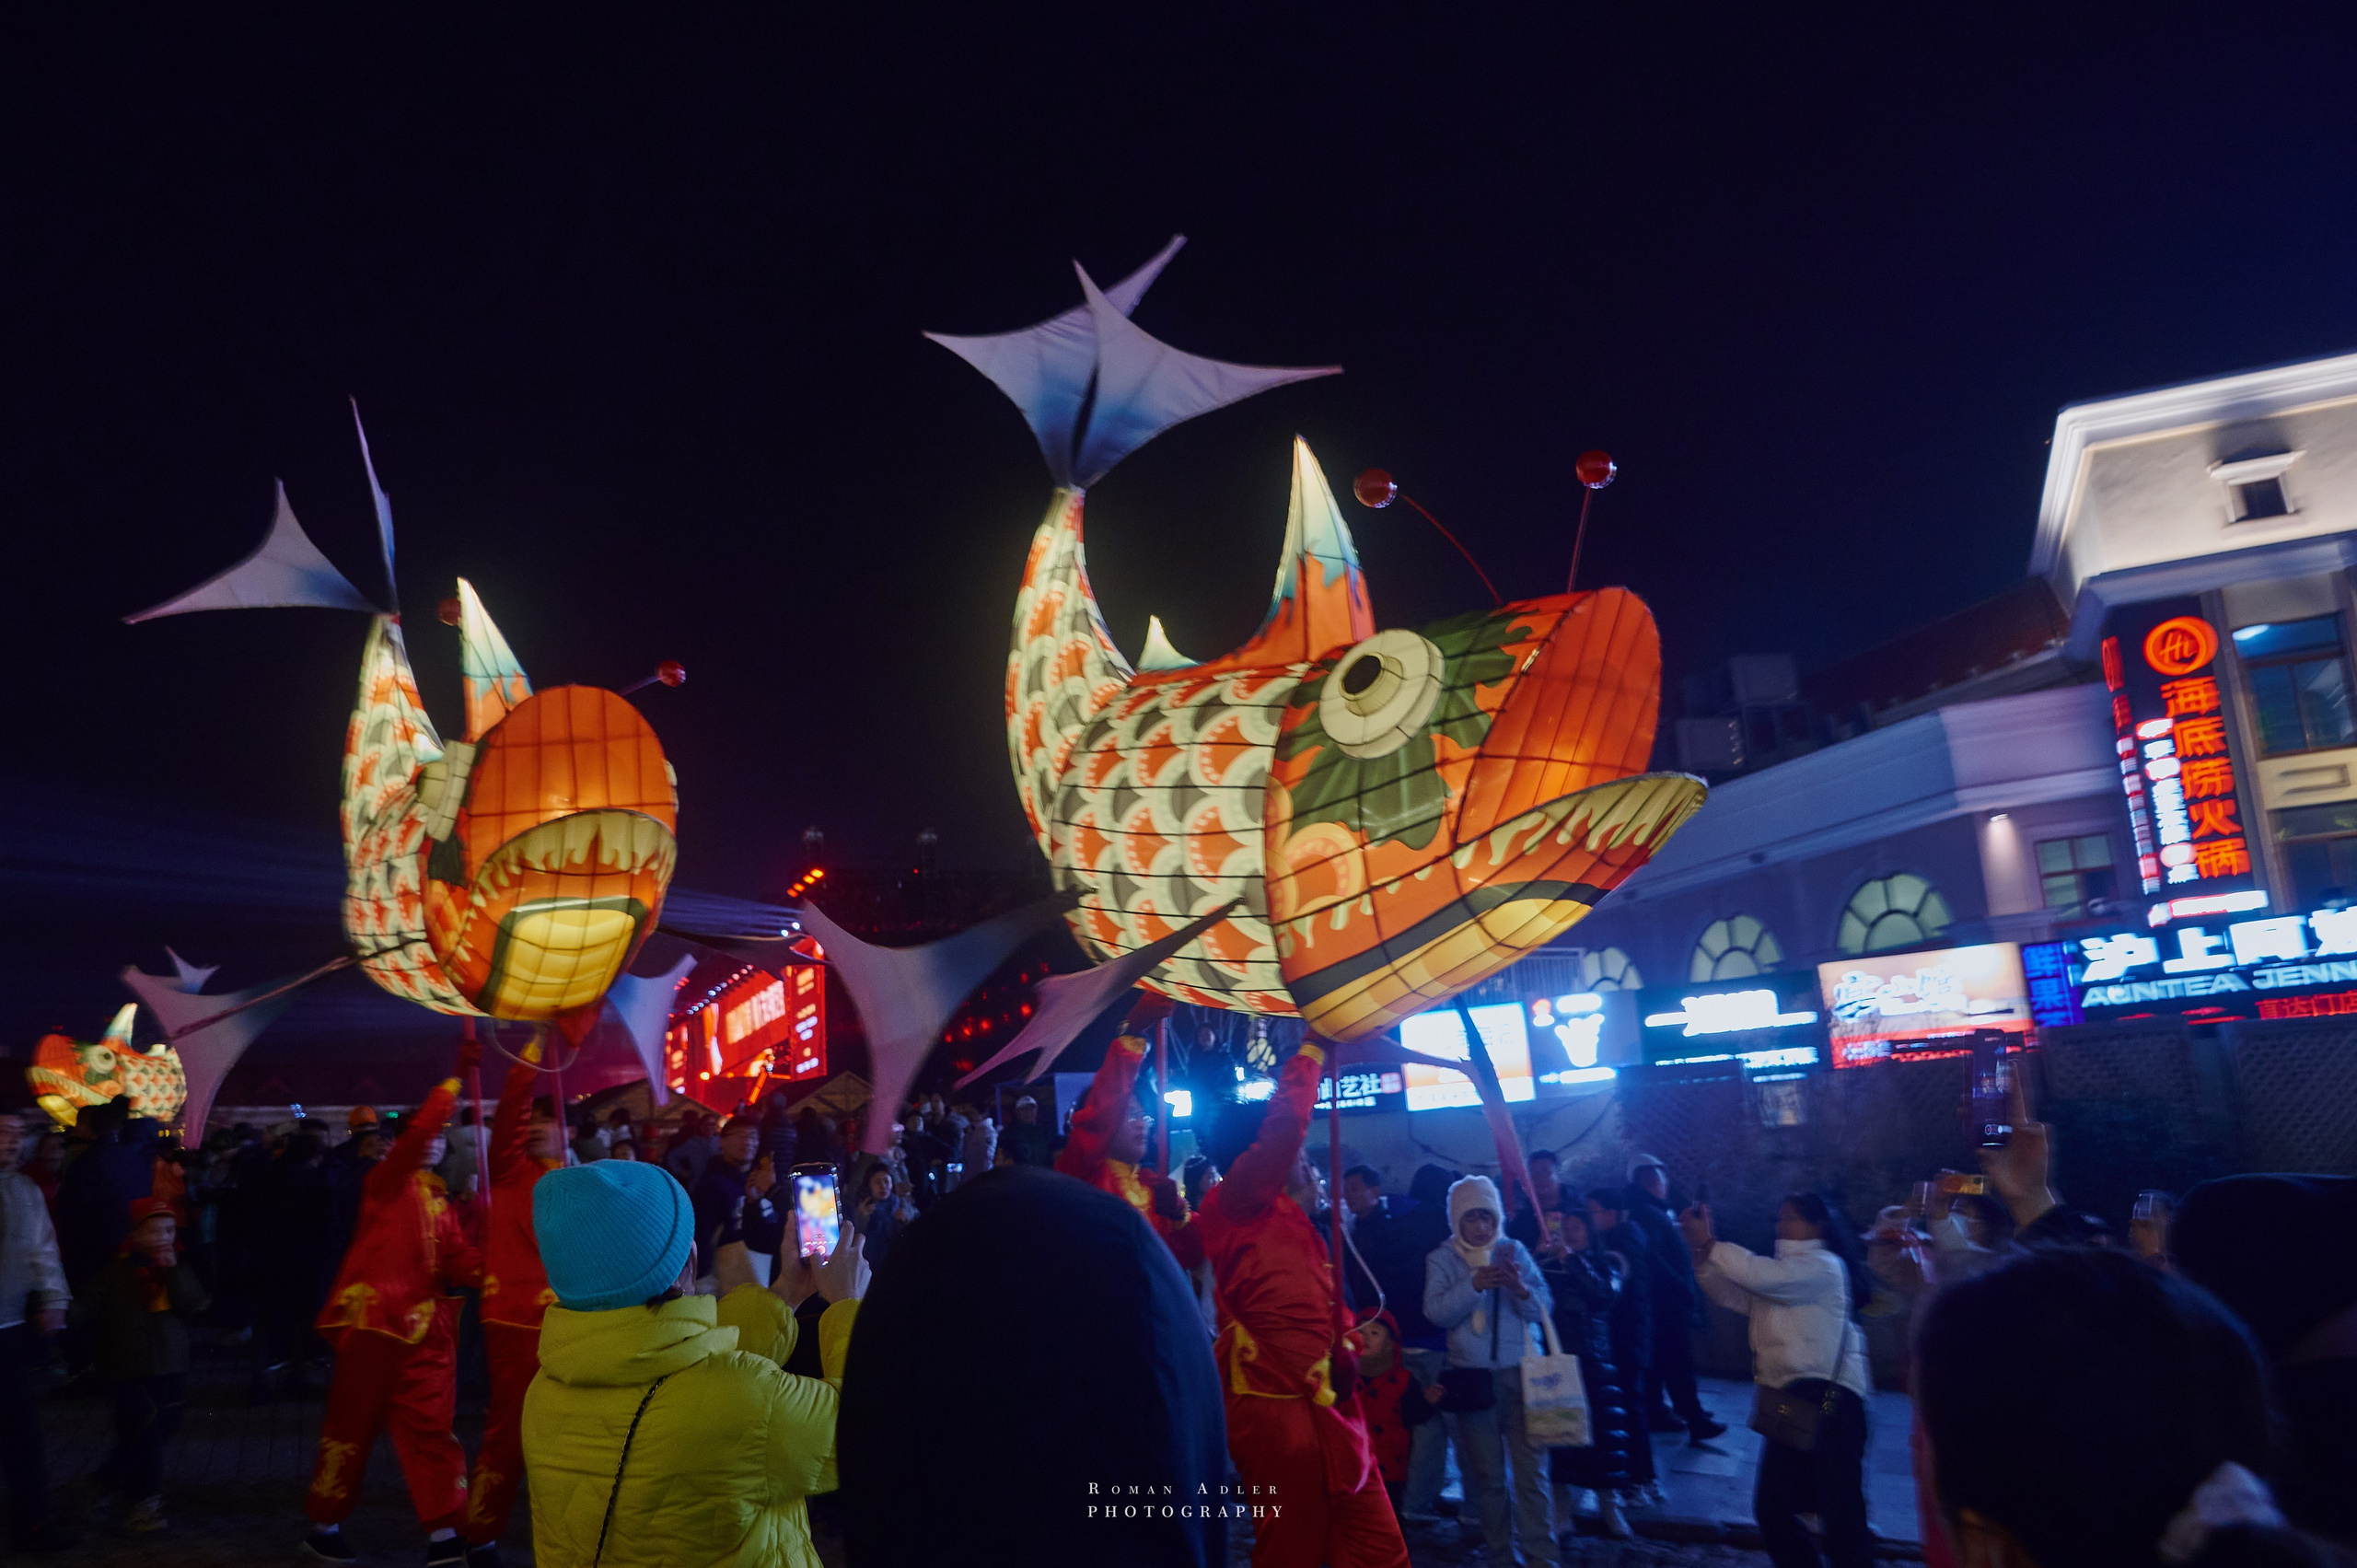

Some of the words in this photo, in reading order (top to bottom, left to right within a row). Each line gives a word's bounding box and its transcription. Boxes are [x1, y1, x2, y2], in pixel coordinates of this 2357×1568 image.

[2159, 675, 2251, 879] 海底捞火锅
[2081, 972, 2251, 1008] AUNTEA
